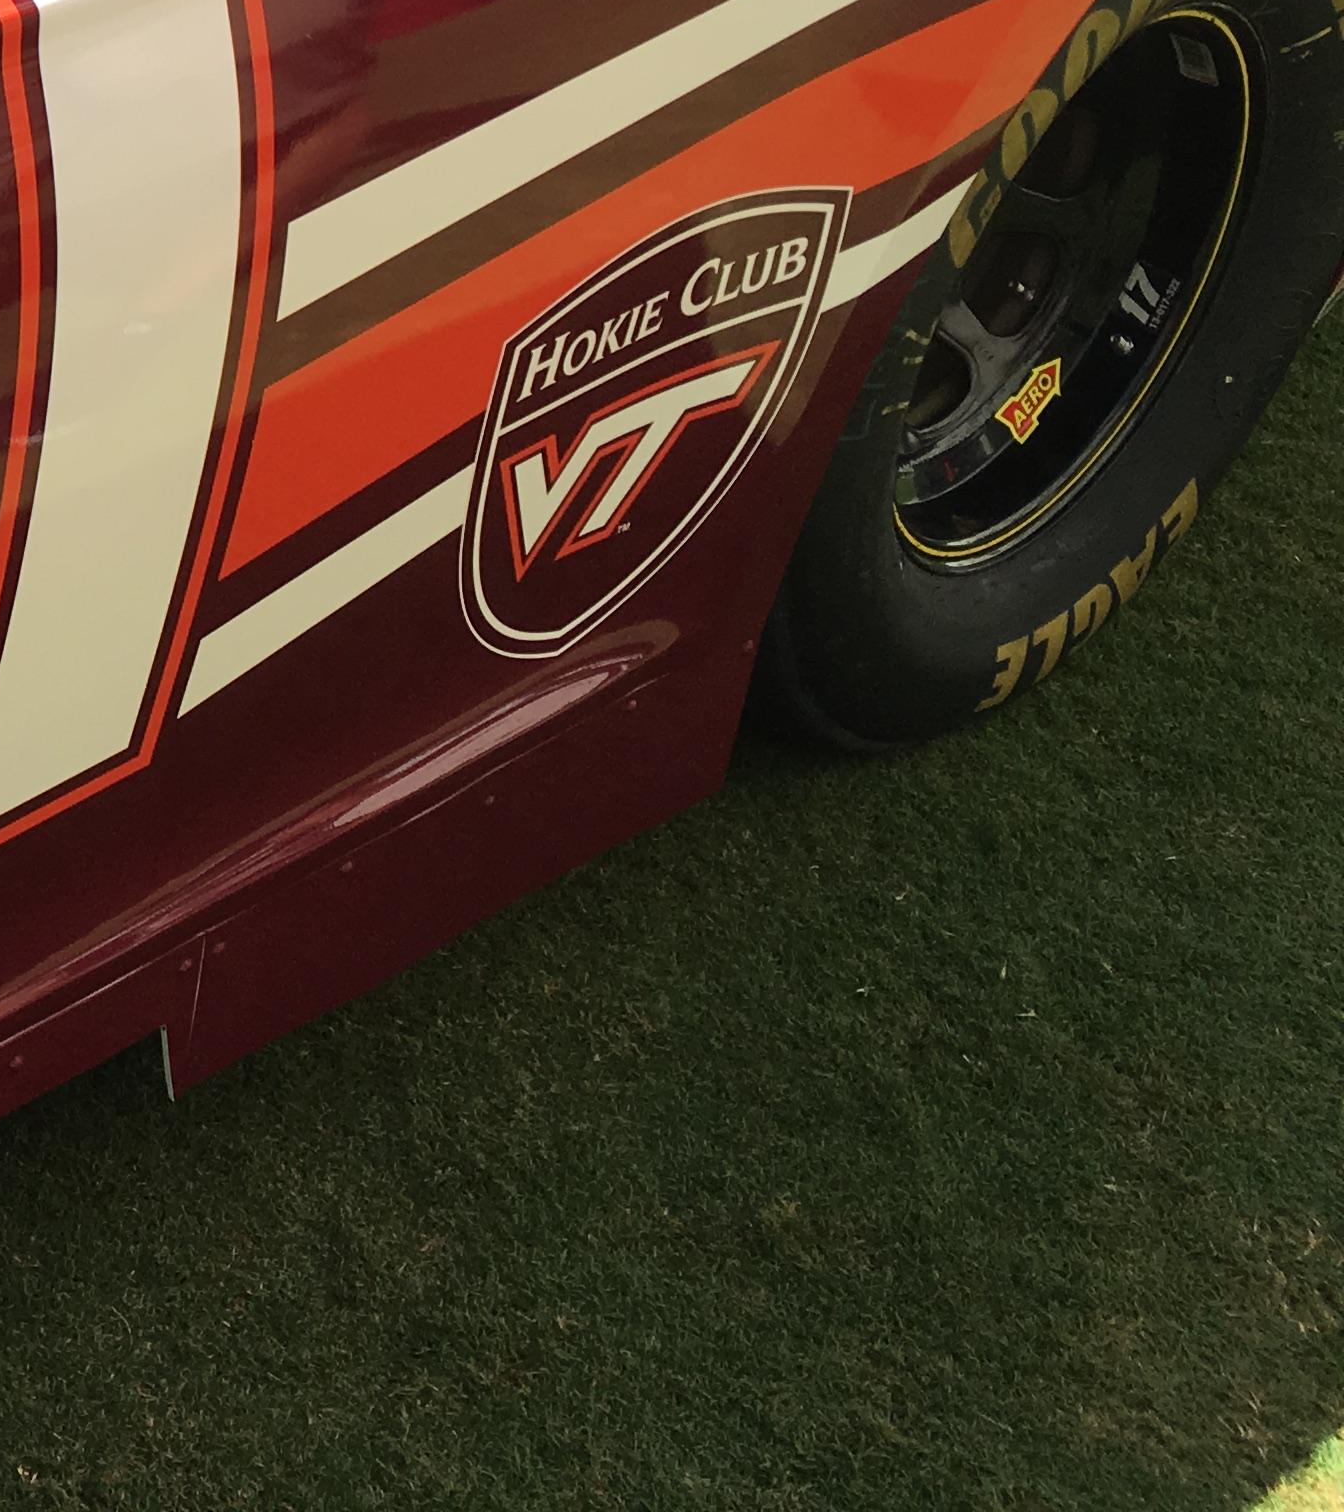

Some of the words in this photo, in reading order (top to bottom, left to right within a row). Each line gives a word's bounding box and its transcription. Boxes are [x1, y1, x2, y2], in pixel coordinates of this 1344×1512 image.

[516, 291, 671, 402] HOKIE
[679, 236, 810, 317] CLUB
[1118, 262, 1161, 326] 17
[499, 339, 783, 583] VT
[1013, 372, 1052, 428] AERO
[974, 477, 1199, 713] EAGLE
